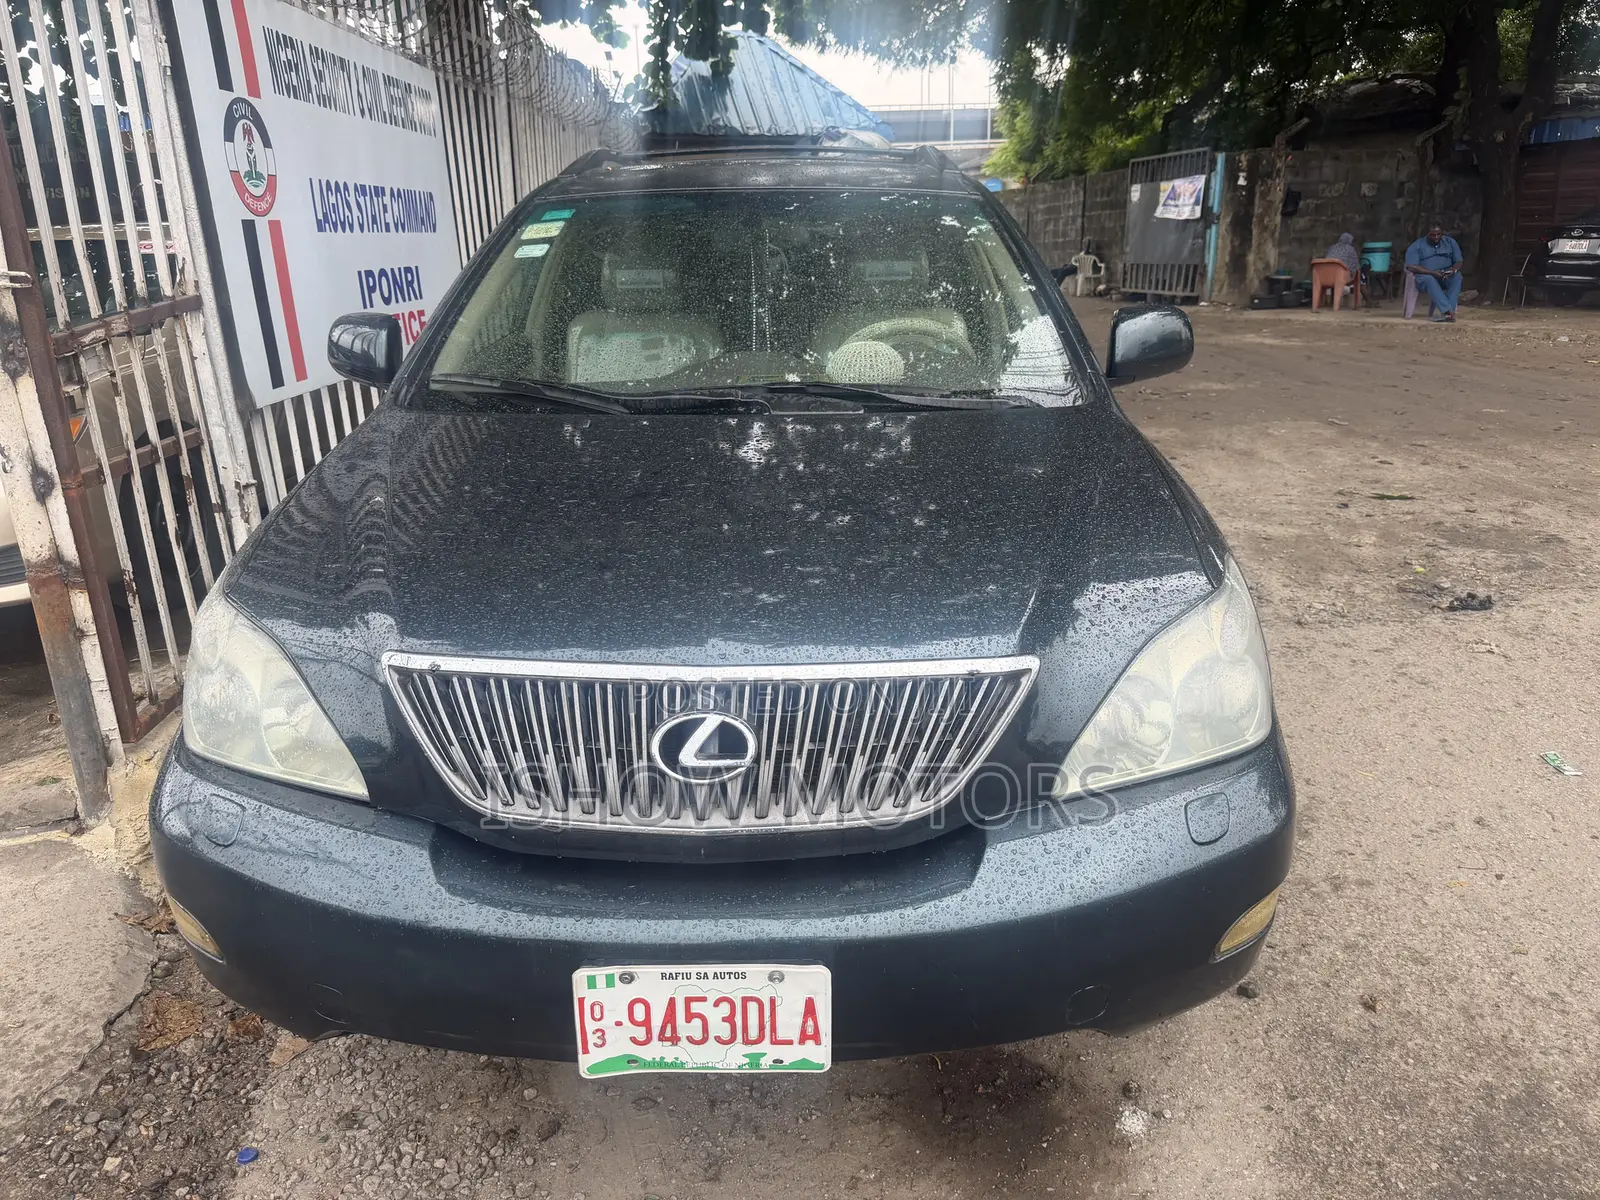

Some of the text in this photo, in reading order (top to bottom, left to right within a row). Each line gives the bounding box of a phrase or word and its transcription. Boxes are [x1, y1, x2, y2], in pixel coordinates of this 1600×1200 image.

[262, 25, 315, 105] NIGERIA
[309, 43, 356, 116] SECURITY
[354, 61, 365, 119] &
[362, 64, 388, 124] CIVIL
[382, 73, 418, 133] DEFENCE
[232, 102, 254, 120] CIVIL
[244, 192, 272, 211] DEFENCE
[309, 177, 437, 234] LAGOS STATE COMMAND
[357, 265, 424, 310] IPONRI
[660, 971, 747, 980] RAFIU SA AUTOS
[643, 1060, 678, 1069] FEDERAL
[734, 1061, 769, 1069] NIGERIA
